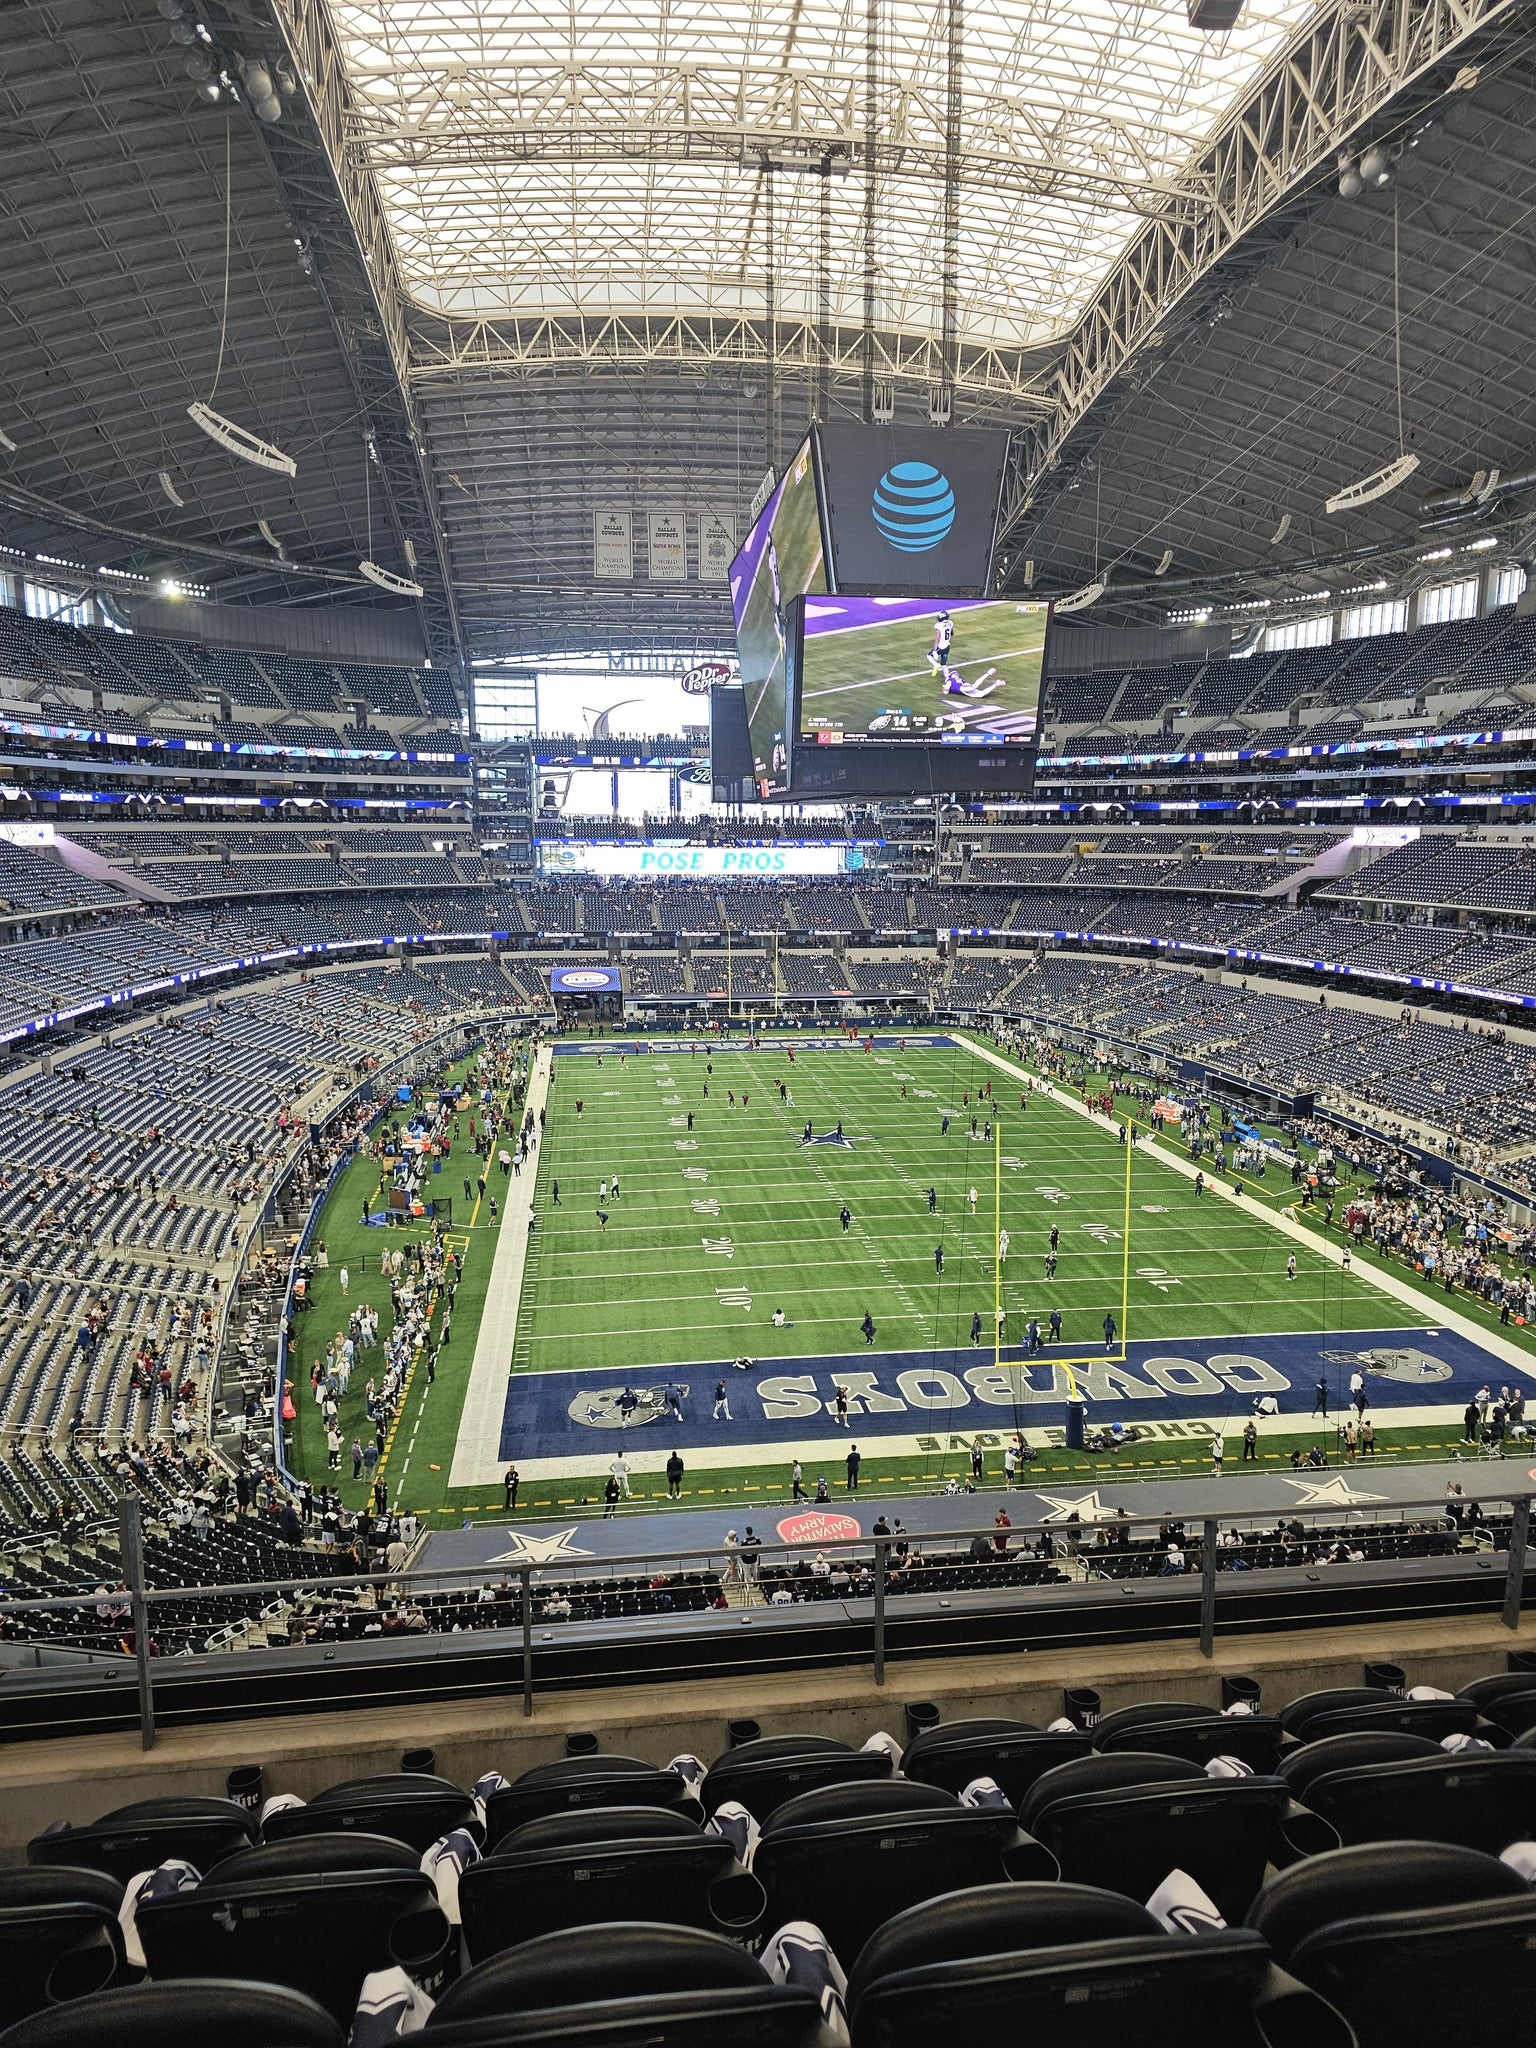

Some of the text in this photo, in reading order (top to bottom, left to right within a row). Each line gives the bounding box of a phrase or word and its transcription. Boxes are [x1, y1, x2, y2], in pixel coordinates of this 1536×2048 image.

[944, 628, 950, 640] 6
[685, 670, 730, 692] Pepper
[704, 667, 719, 679] Dr
[893, 716, 908, 726] 14
[935, 717, 944, 727] 9
[641, 852, 786, 870] POSE PROS
[690, 1198, 721, 1213] 30
[1080, 1223, 1123, 1239] 20
[701, 1236, 735, 1255] 20
[1136, 1267, 1184, 1286] 10
[714, 1285, 753, 1306] 10
[755, 1354, 1292, 1420] COWBOYS
[790, 1516, 826, 1537] ARMY
